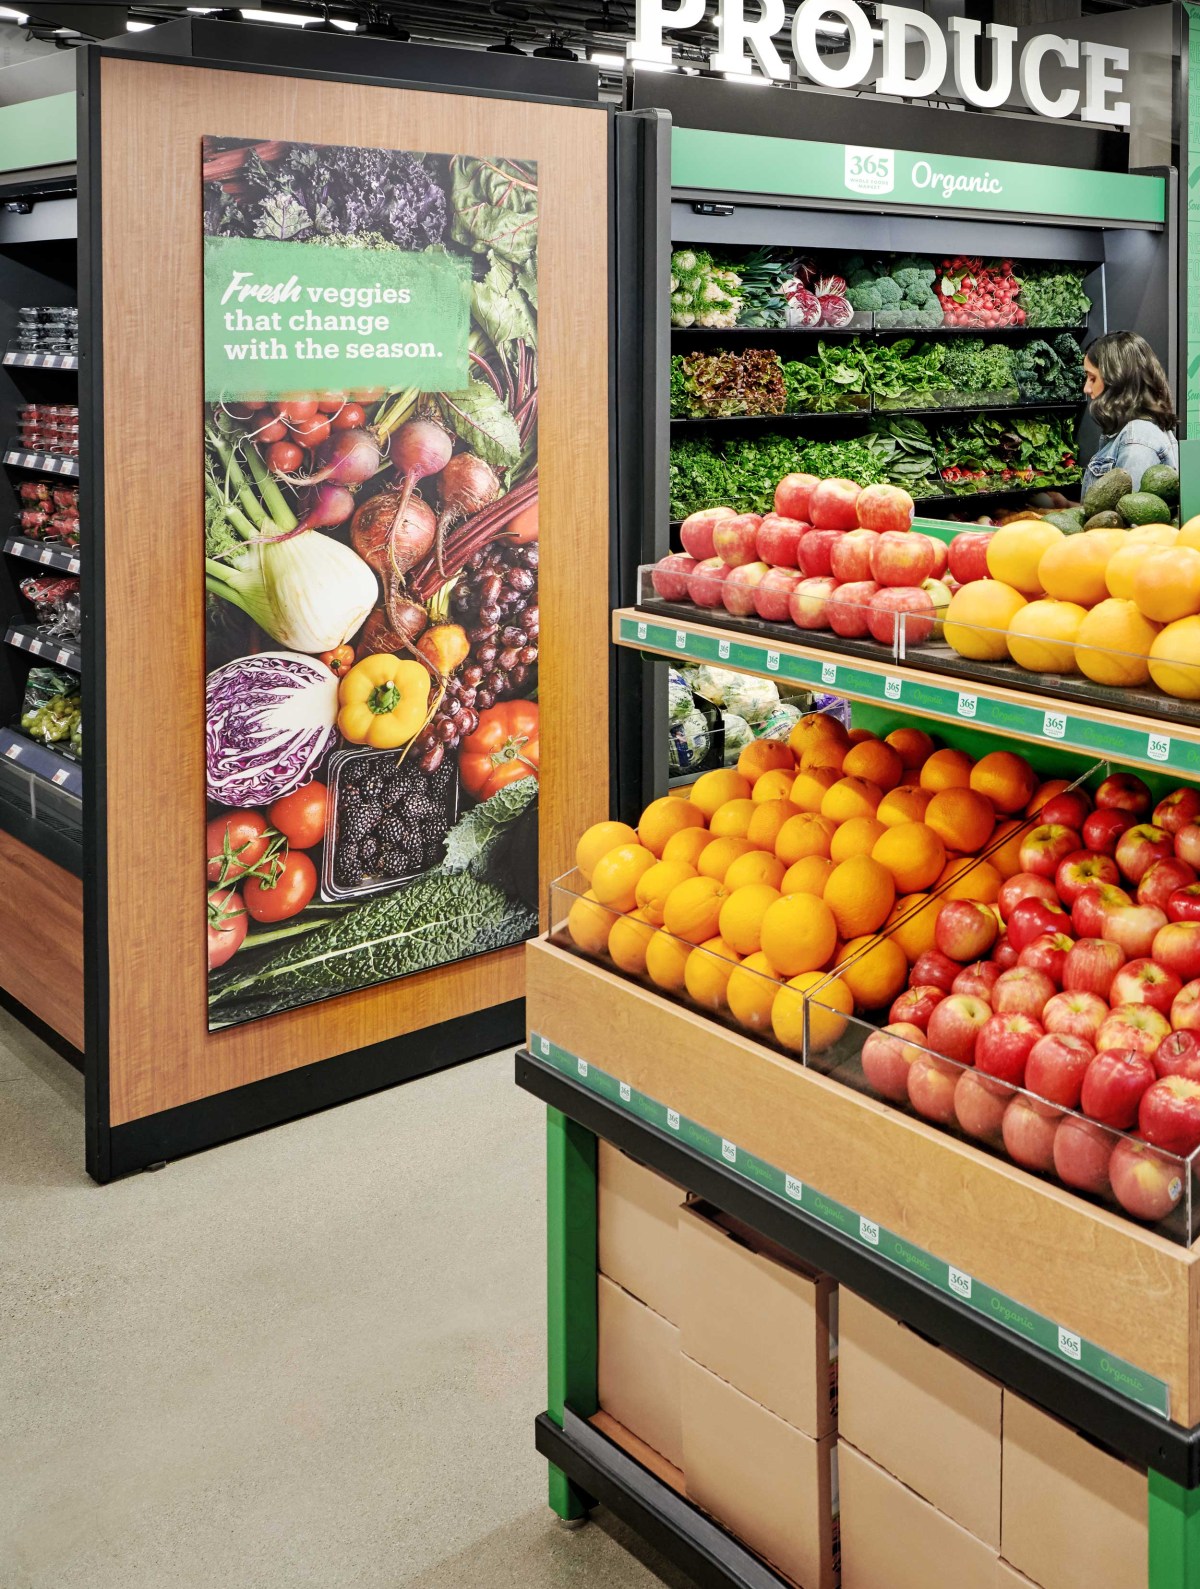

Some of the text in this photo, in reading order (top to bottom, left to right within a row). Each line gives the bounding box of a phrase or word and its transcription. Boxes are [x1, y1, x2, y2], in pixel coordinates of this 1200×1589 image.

[626, 0, 1131, 126] PRODUCE
[850, 155, 889, 177] 365
[911, 161, 1003, 198] Organic
[220, 270, 411, 308] Fresh veggies
[224, 309, 390, 335] that change
[224, 338, 443, 360] with the season.
[822, 667, 835, 678] 365
[886, 682, 900, 693] 365
[959, 698, 975, 710] 365
[1045, 717, 1064, 730] 365
[1149, 740, 1167, 753] 365
[723, 1145, 735, 1157] 365
[787, 1180, 800, 1193] 365
[861, 1223, 877, 1237] 365
[895, 1243, 931, 1271] Organic
[950, 1273, 969, 1291] 365
[990, 1297, 1035, 1330] Organic
[1060, 1335, 1079, 1352] 365
[1100, 1358, 1144, 1391] Organic
